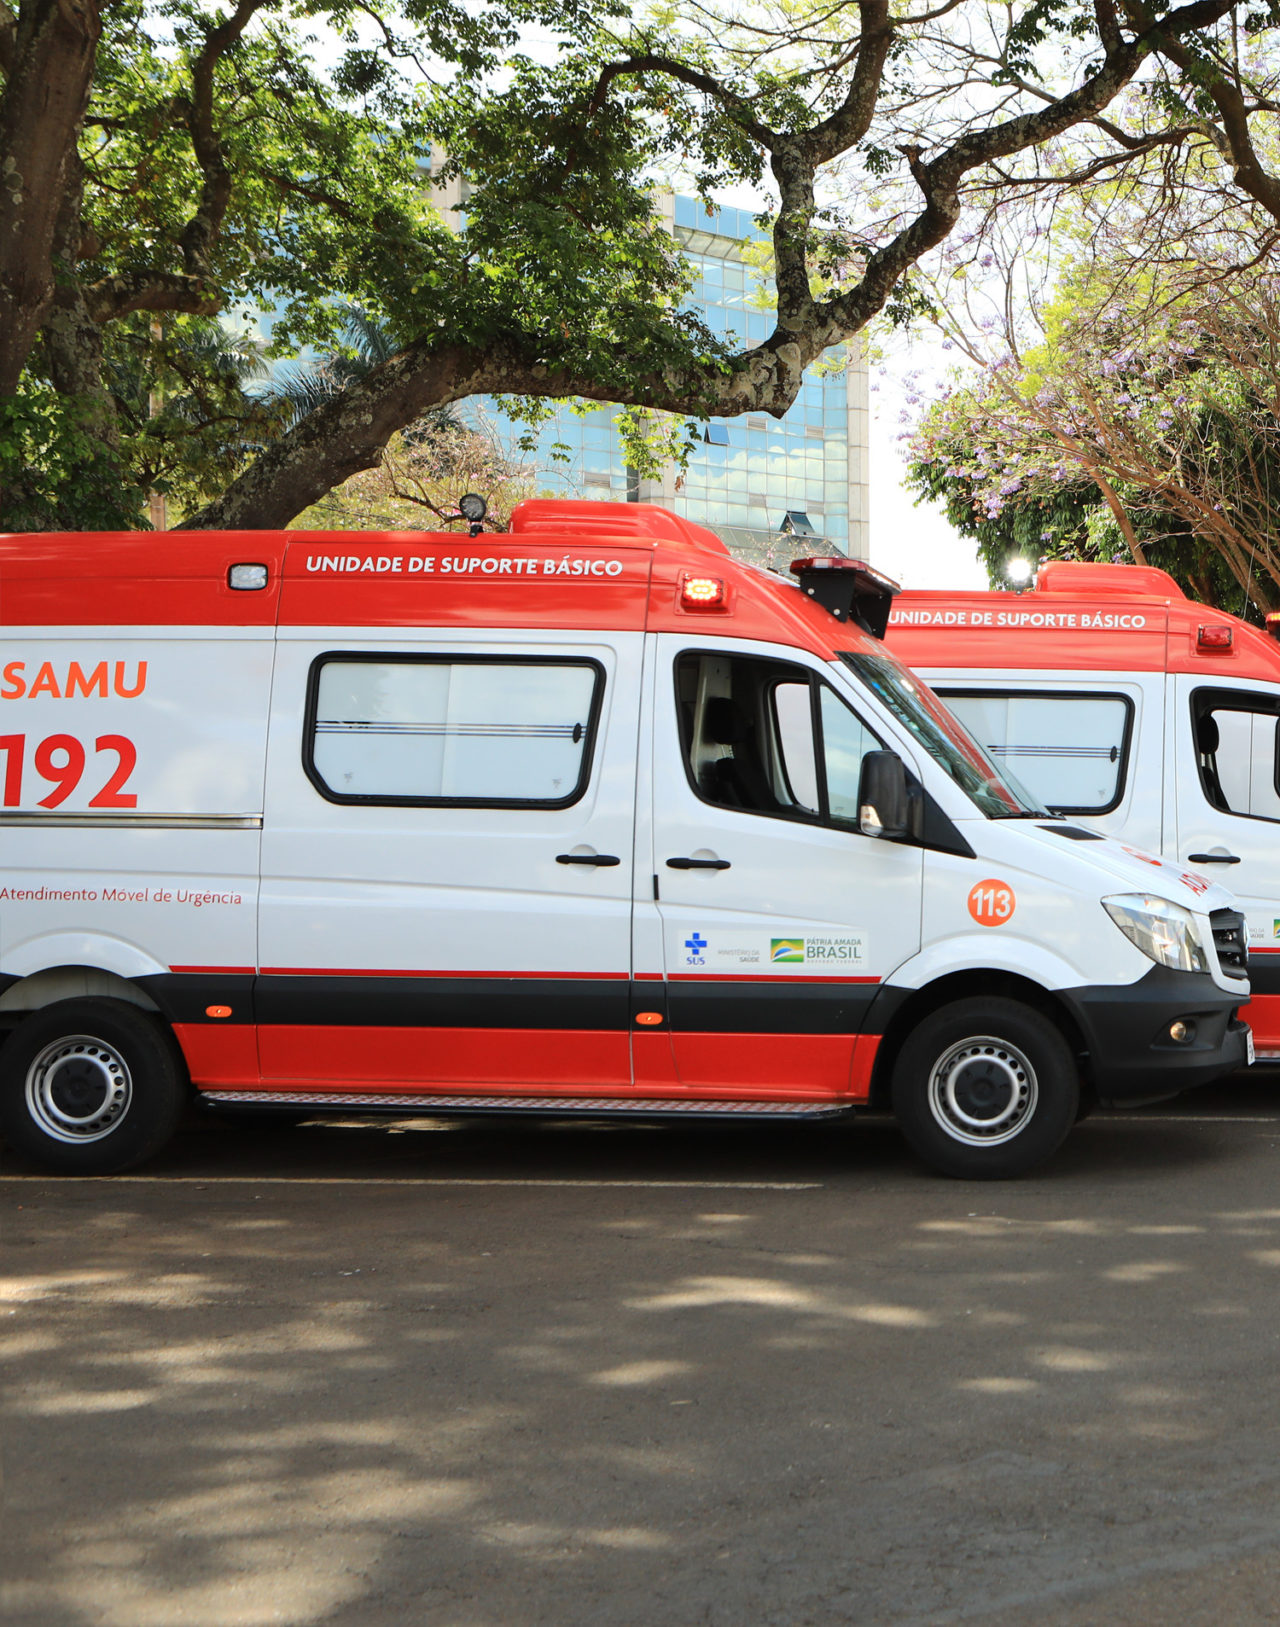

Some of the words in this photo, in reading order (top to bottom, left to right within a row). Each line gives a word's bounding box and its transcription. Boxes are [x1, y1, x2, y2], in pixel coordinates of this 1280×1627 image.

[306, 556, 403, 573] UNIDADE
[408, 557, 436, 573] DE
[440, 557, 537, 575] SUPORTE
[543, 555, 623, 576] BÁSICO
[888, 611, 966, 625] UNIDADE
[971, 612, 992, 625] DE
[997, 612, 1076, 627] SUPORTE
[1081, 610, 1146, 628] BÁSICO
[0, 661, 148, 700] SAMU
[0, 733, 138, 810] 192
[0, 887, 97, 901] Atendimento
[102, 888, 148, 902] Móvel
[153, 888, 172, 902] de
[177, 889, 242, 908] Urgência
[972, 888, 1011, 917] 113
[686, 956, 705, 965] SUS
[806, 946, 862, 959] BRASIL
